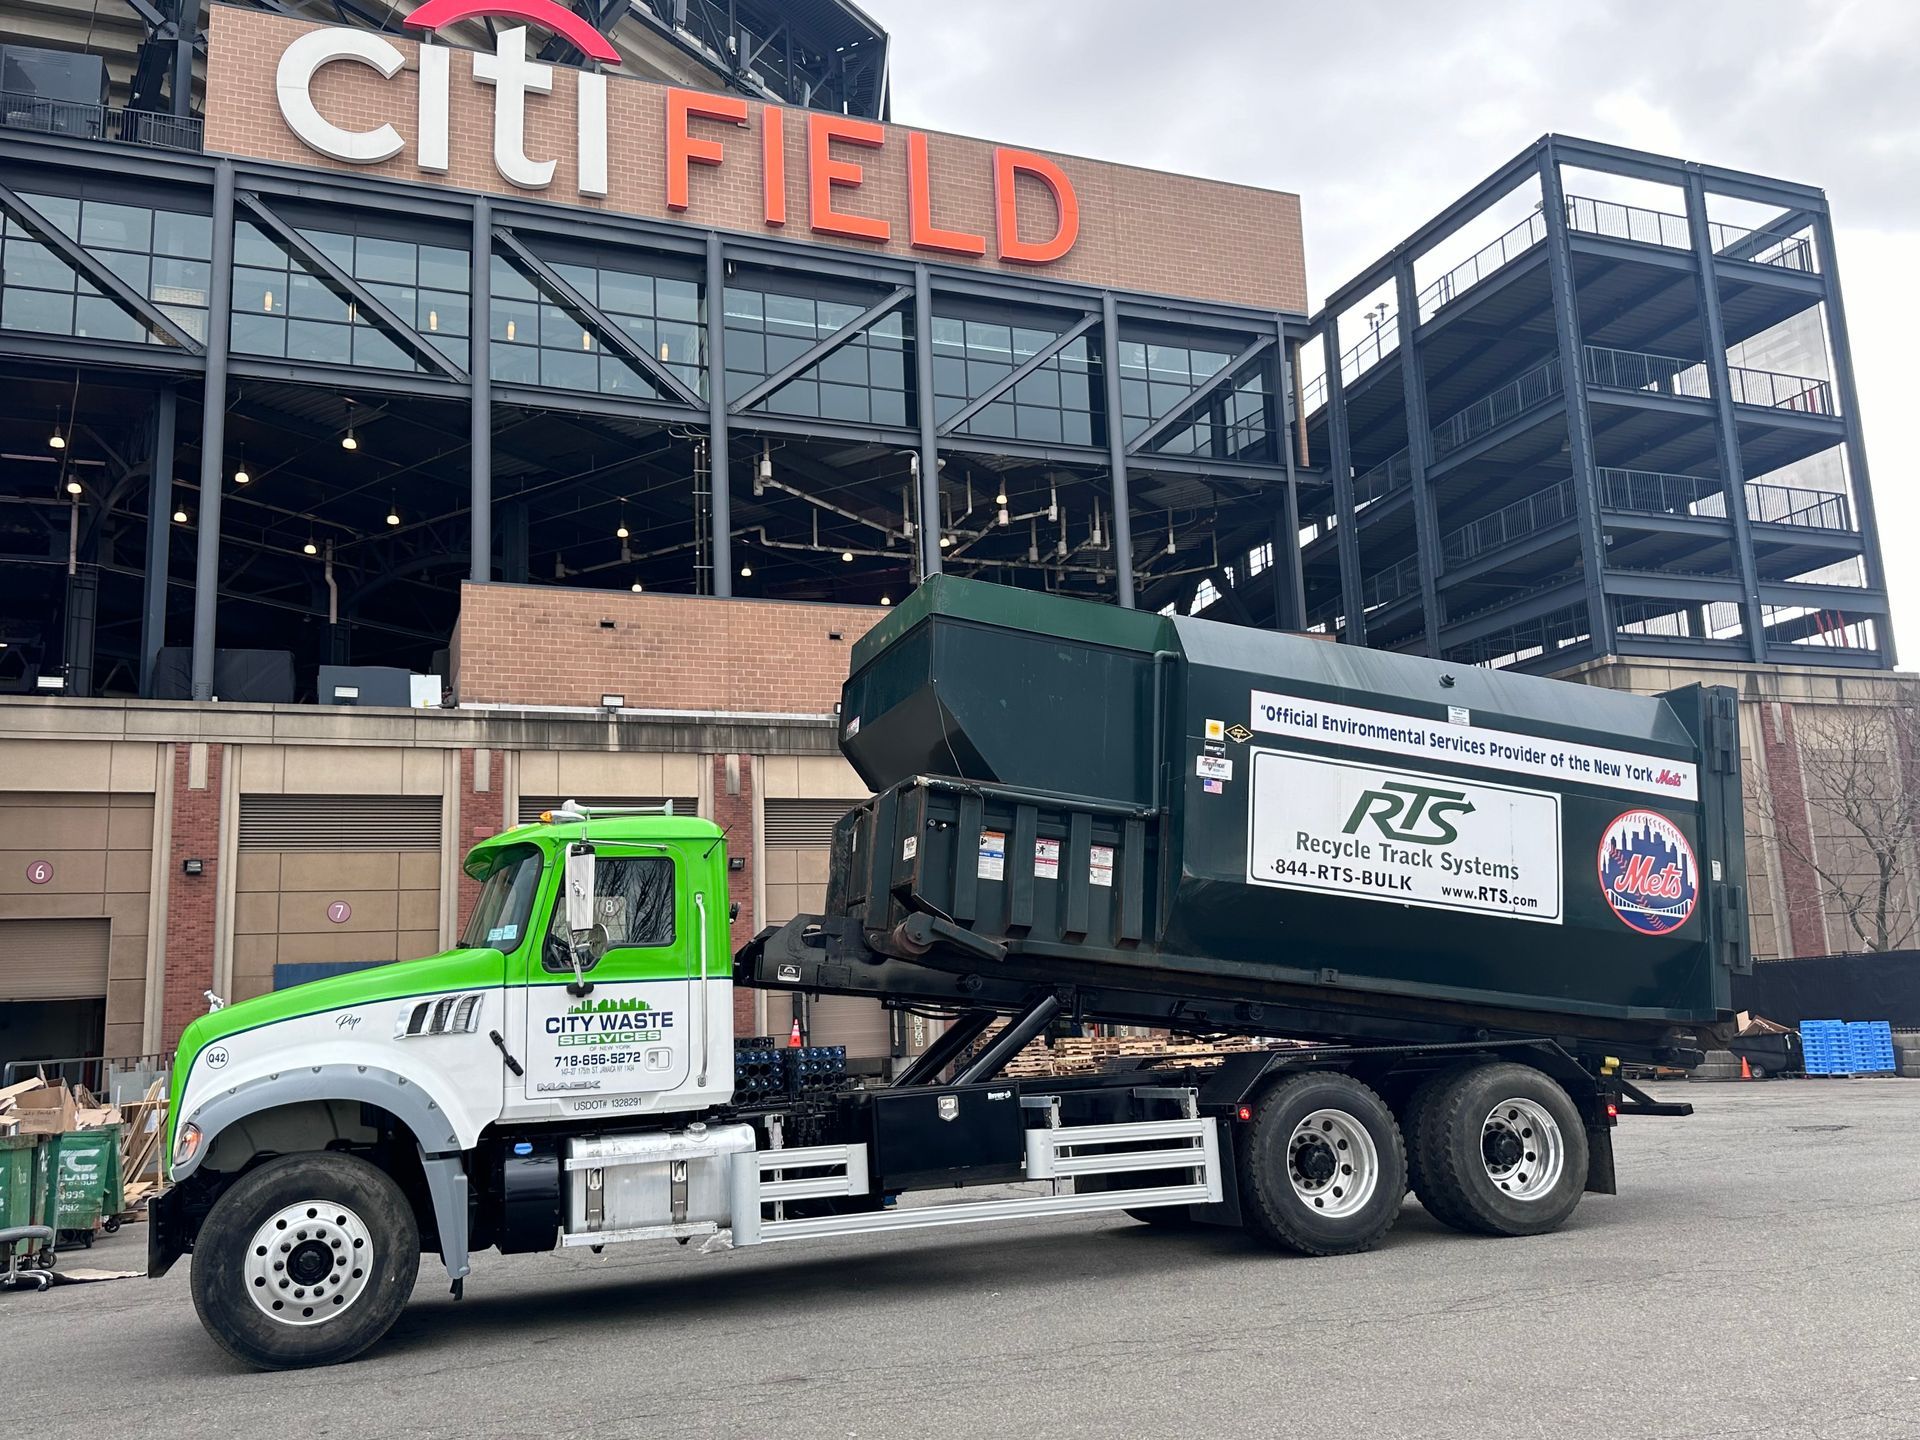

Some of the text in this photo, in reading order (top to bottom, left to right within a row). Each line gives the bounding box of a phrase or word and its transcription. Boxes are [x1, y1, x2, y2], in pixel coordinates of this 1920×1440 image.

[276, 25, 1080, 266] citi FIELD
[1322, 715, 1425, 745] Environmental
[1430, 732, 1485, 755] Services
[1490, 742, 1546, 765] Provider
[1550, 753, 1564, 768] of
[1568, 755, 1590, 772] the
[1594, 759, 1621, 777] New
[1625, 764, 1653, 782] York
[1342, 781, 1476, 846] RTS
[1296, 831, 1520, 881] Recycle Track Systems
[35, 865, 45, 880] 6
[1614, 853, 1683, 899] Mets
[1441, 885, 1538, 908] www.RTS.com
[335, 906, 344, 919] 7
[606, 900, 613, 913] 8
[336, 1013, 361, 1030] Pop
[546, 1011, 674, 1034] CITY WASTE
[559, 1030, 661, 1046] SERVICES
[208, 1053, 226, 1063] Q42
[537, 1080, 600, 1091] MACK
[573, 1097, 642, 1111] USDOT# 1328291
